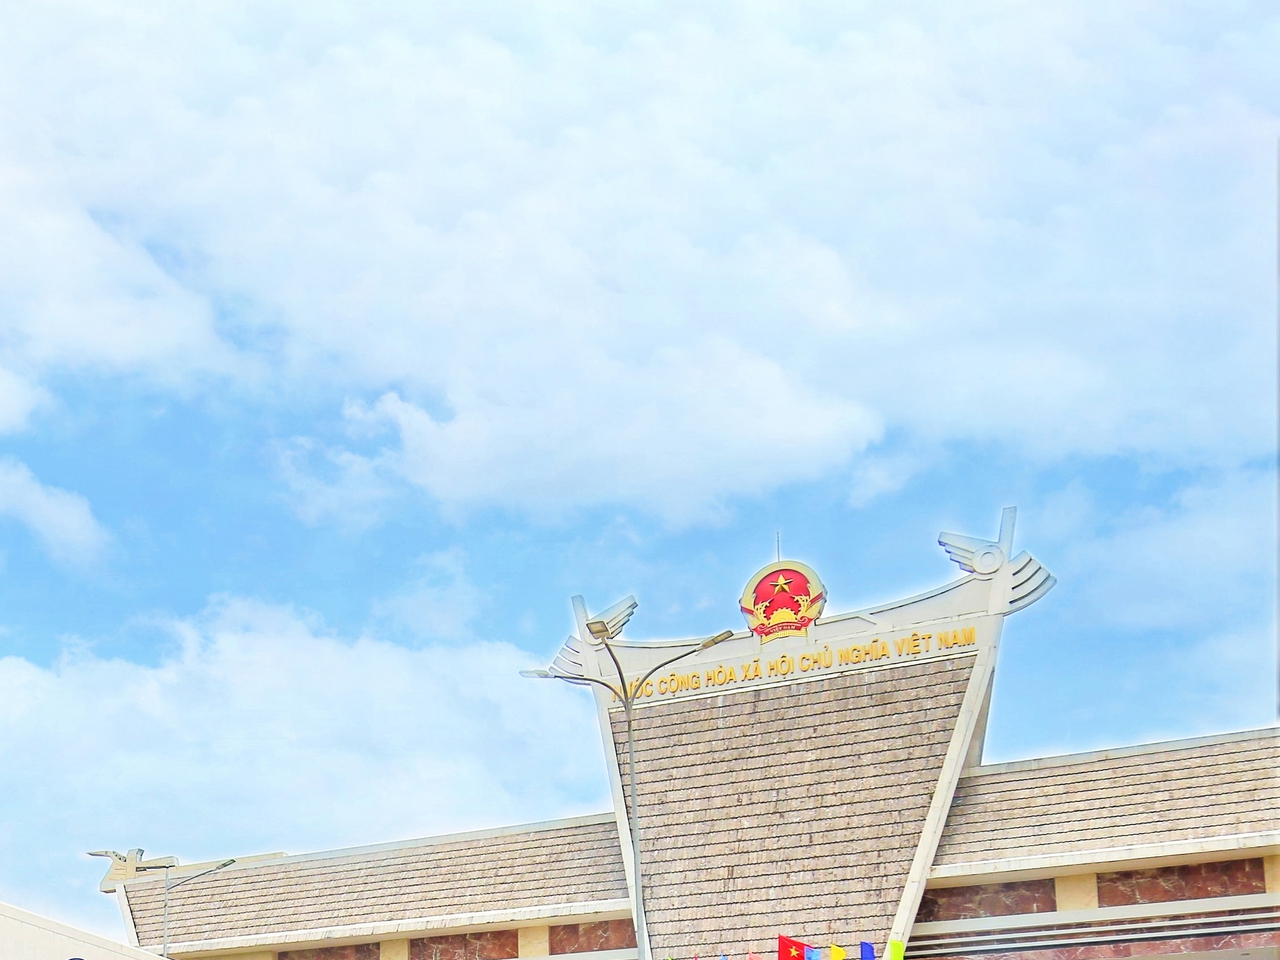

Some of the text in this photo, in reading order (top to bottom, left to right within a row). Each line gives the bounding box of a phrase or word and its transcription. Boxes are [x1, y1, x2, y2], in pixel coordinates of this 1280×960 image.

[657, 674, 700, 697] CỘNG
[705, 665, 738, 688] HÒA
[741, 658, 763, 681] XÃ
[767, 655, 795, 679] HỘI
[798, 645, 833, 673] CHỦ
[837, 638, 891, 667] NGHĨA
[893, 633, 932, 659] VIỆT
[937, 626, 976, 651] NAM
